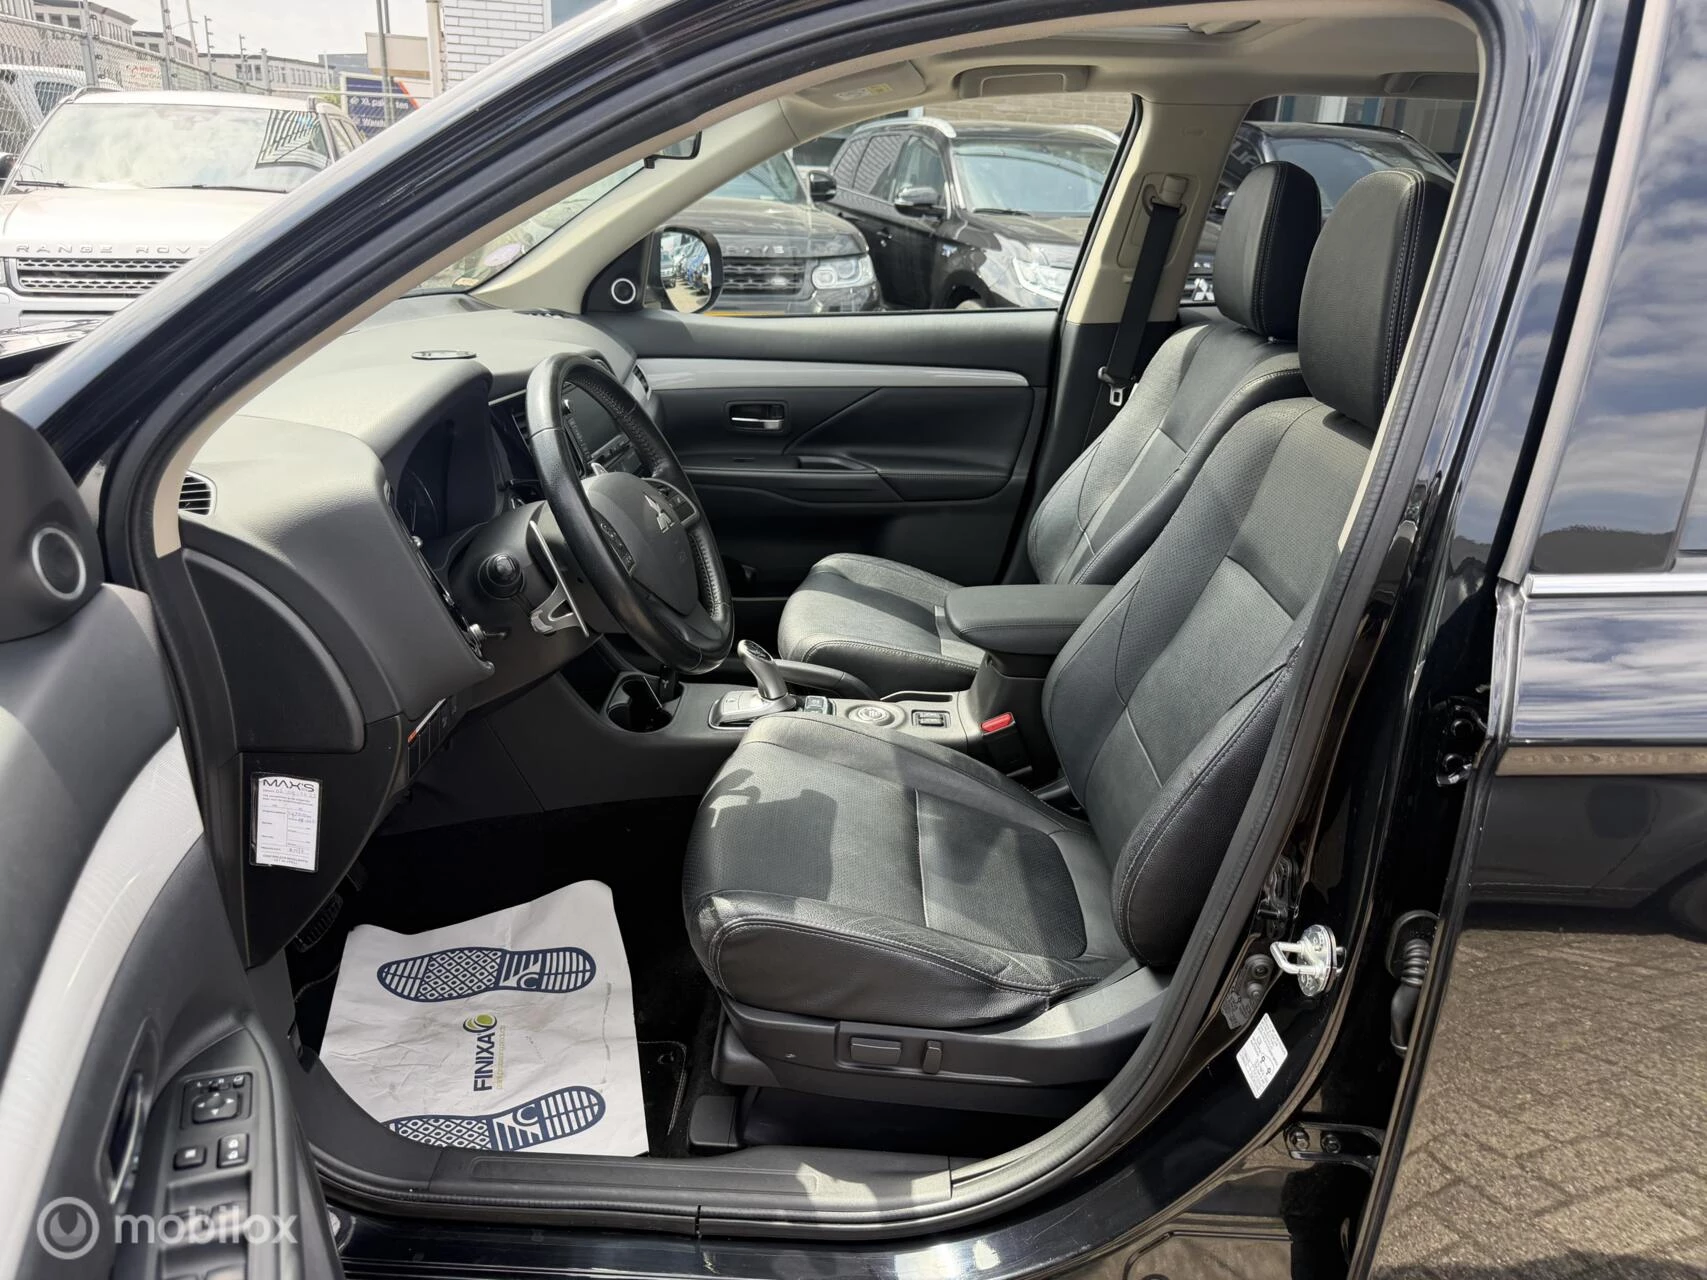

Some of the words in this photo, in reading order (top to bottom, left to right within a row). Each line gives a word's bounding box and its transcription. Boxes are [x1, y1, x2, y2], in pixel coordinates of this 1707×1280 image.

[16, 244, 113, 254] RANGE
[263, 779, 315, 793] MAX'S
[473, 1032, 496, 1092] FINIXA
